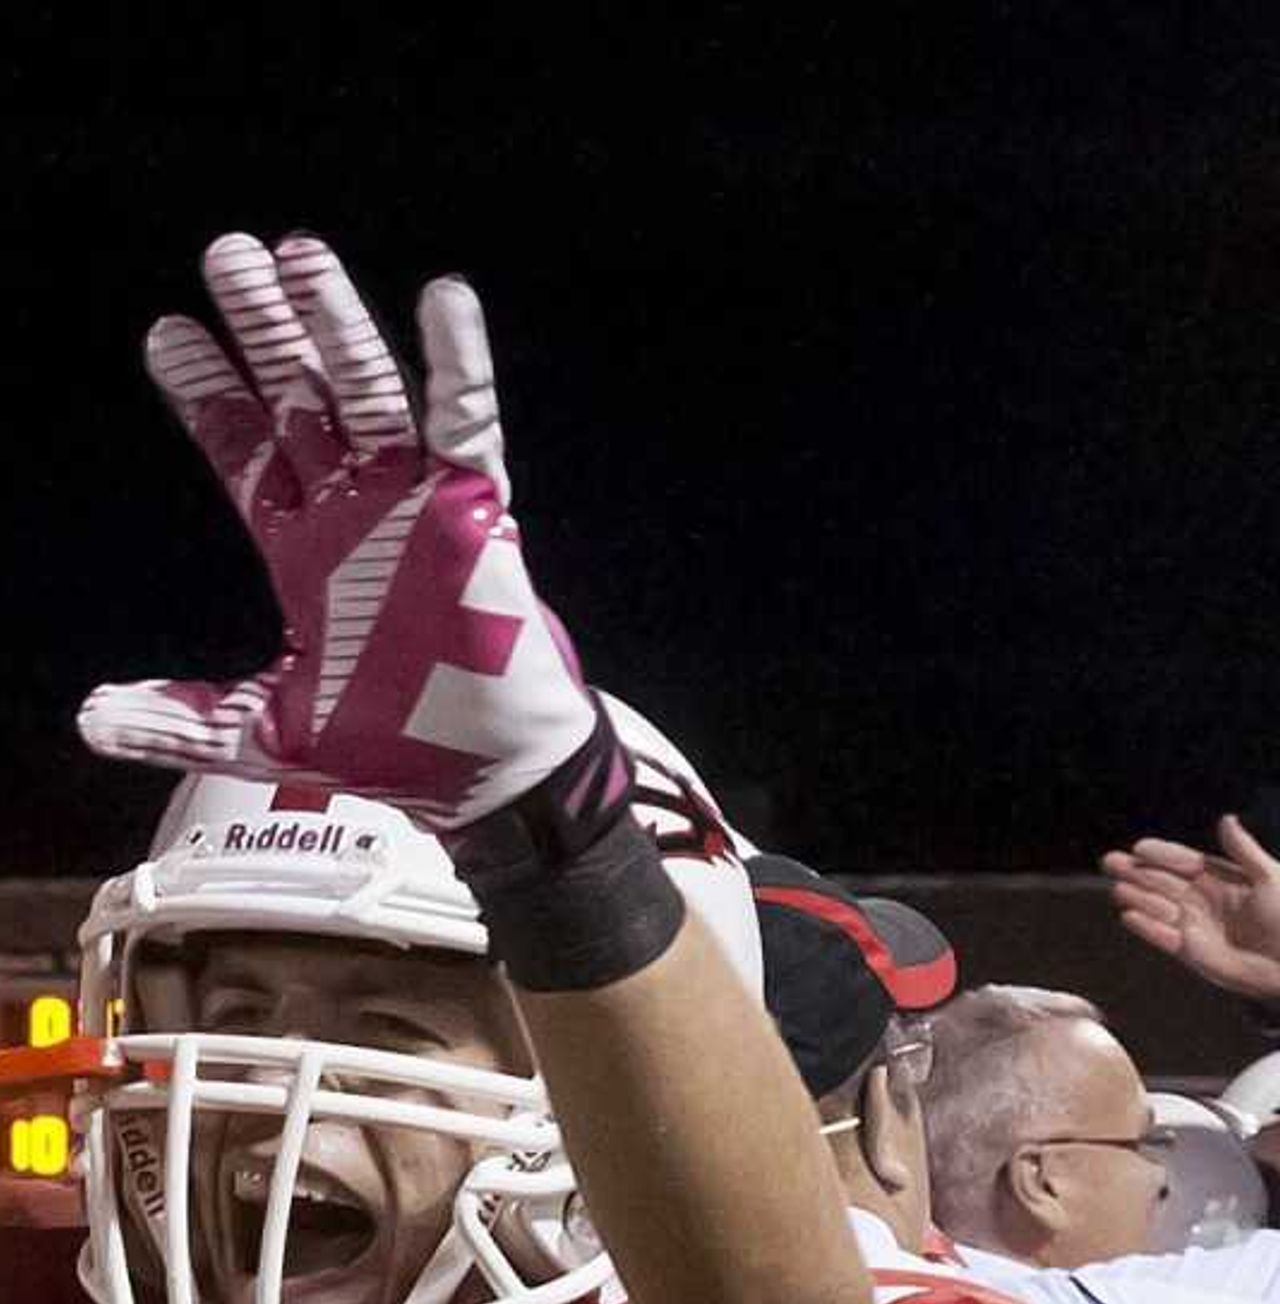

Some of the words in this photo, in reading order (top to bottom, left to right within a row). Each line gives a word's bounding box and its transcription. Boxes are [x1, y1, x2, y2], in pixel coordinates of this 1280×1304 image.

[224, 822, 344, 853] Riddell
[11, 1116, 67, 1175] 10
[118, 1114, 166, 1218] iddell
